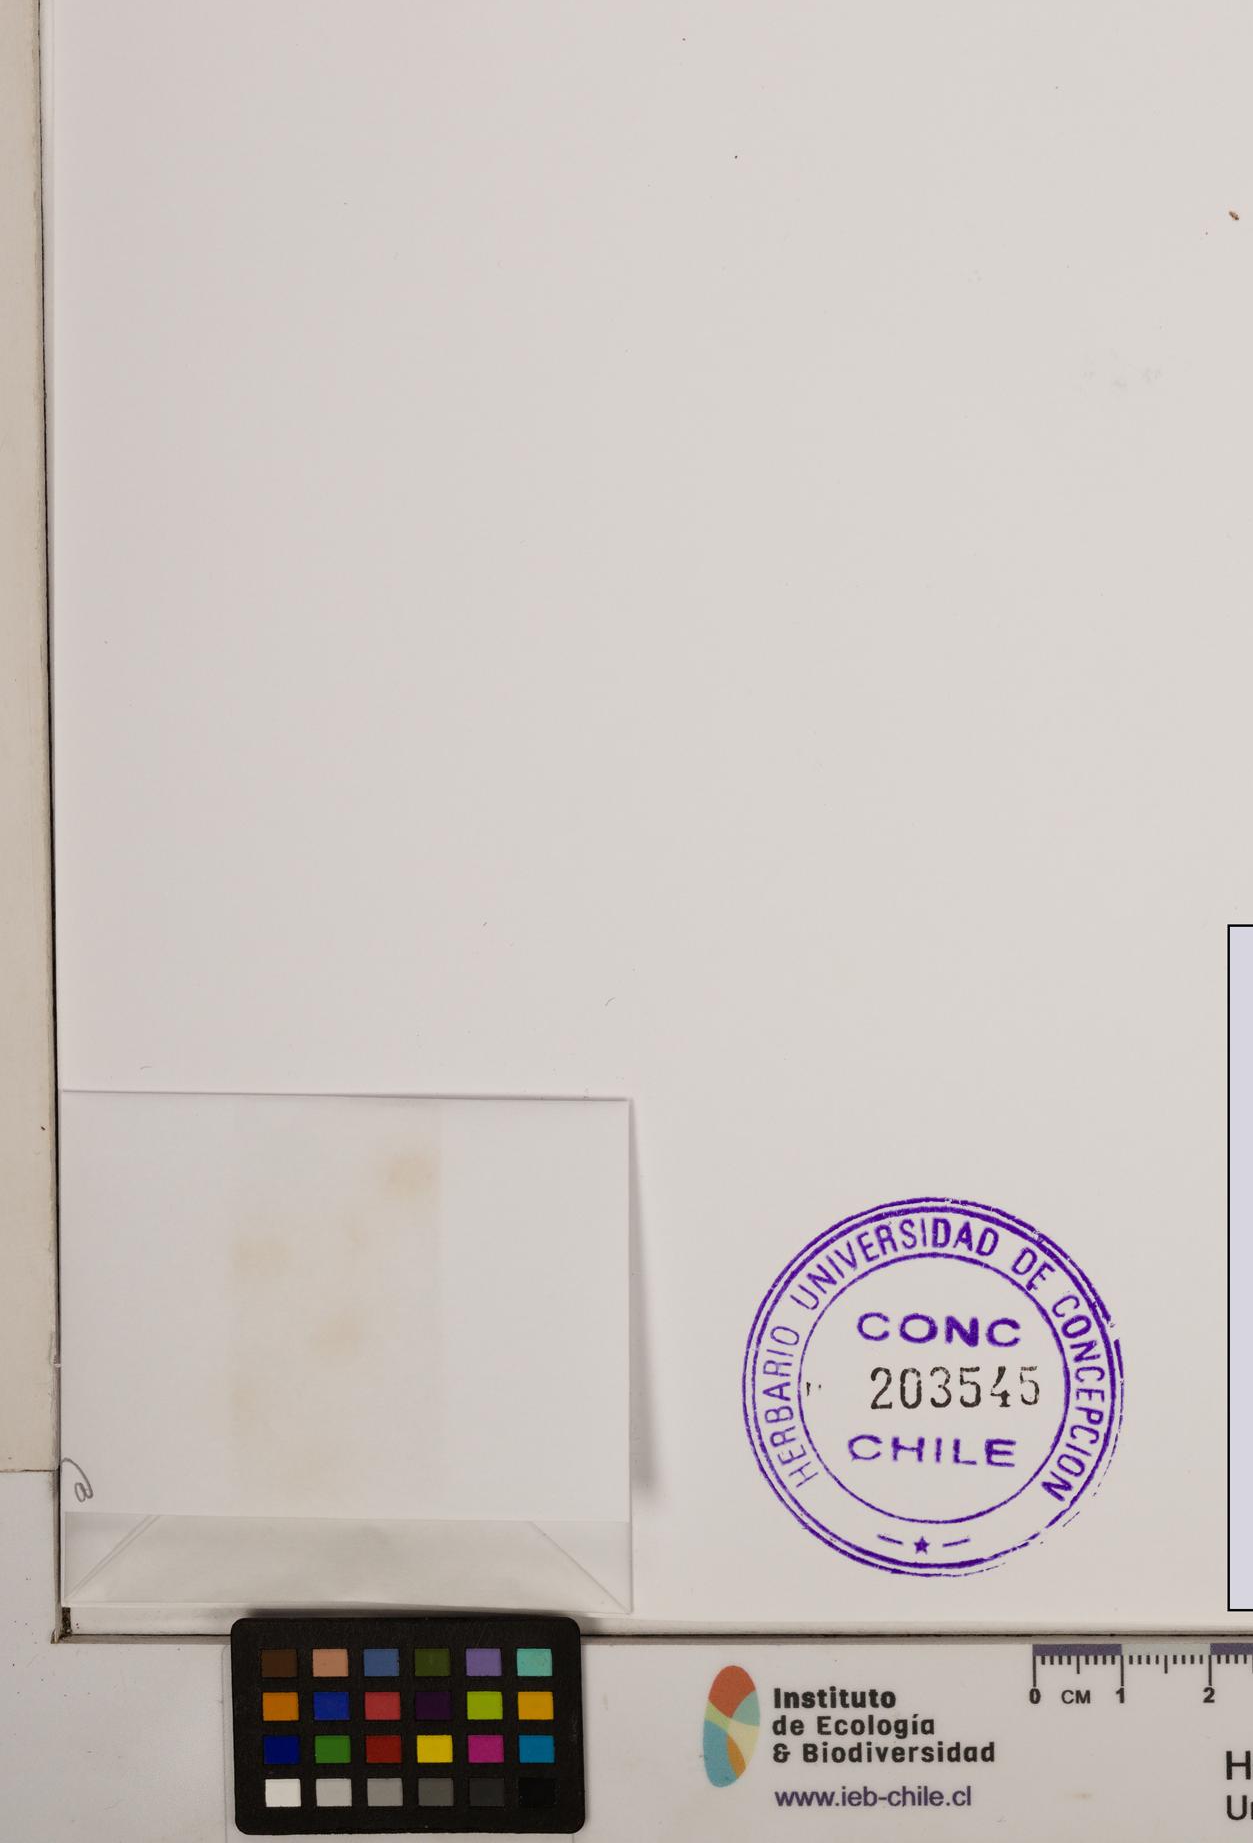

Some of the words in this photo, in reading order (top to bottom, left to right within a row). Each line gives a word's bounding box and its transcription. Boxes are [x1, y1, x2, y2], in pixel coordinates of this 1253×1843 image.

[856, 1311, 1022, 1348] CONC
[762, 1325, 818, 1488] HERBARIO
[790, 1217, 1000, 1311] UNIVERSIDAD
[1011, 1246, 1056, 1292] DE
[1041, 1294, 1106, 1503] CONCEPCION
[870, 1365, 1041, 1410] 203545
[847, 1433, 1017, 1468] CHILE
[773, 1685, 897, 1710] Instituto
[1029, 1687, 1041, 1705] 0
[1060, 1689, 1091, 1705] CM
[1116, 1687, 1126, 1704] 1
[1202, 1687, 1216, 1704] 2
[771, 1714, 805, 1737] de
[816, 1713, 936, 1742] Ecología
[772, 1742, 791, 1764] &
[802, 1740, 995, 1764] Biodiversidad
[774, 1785, 972, 1808] www.ieb-chile.cl
